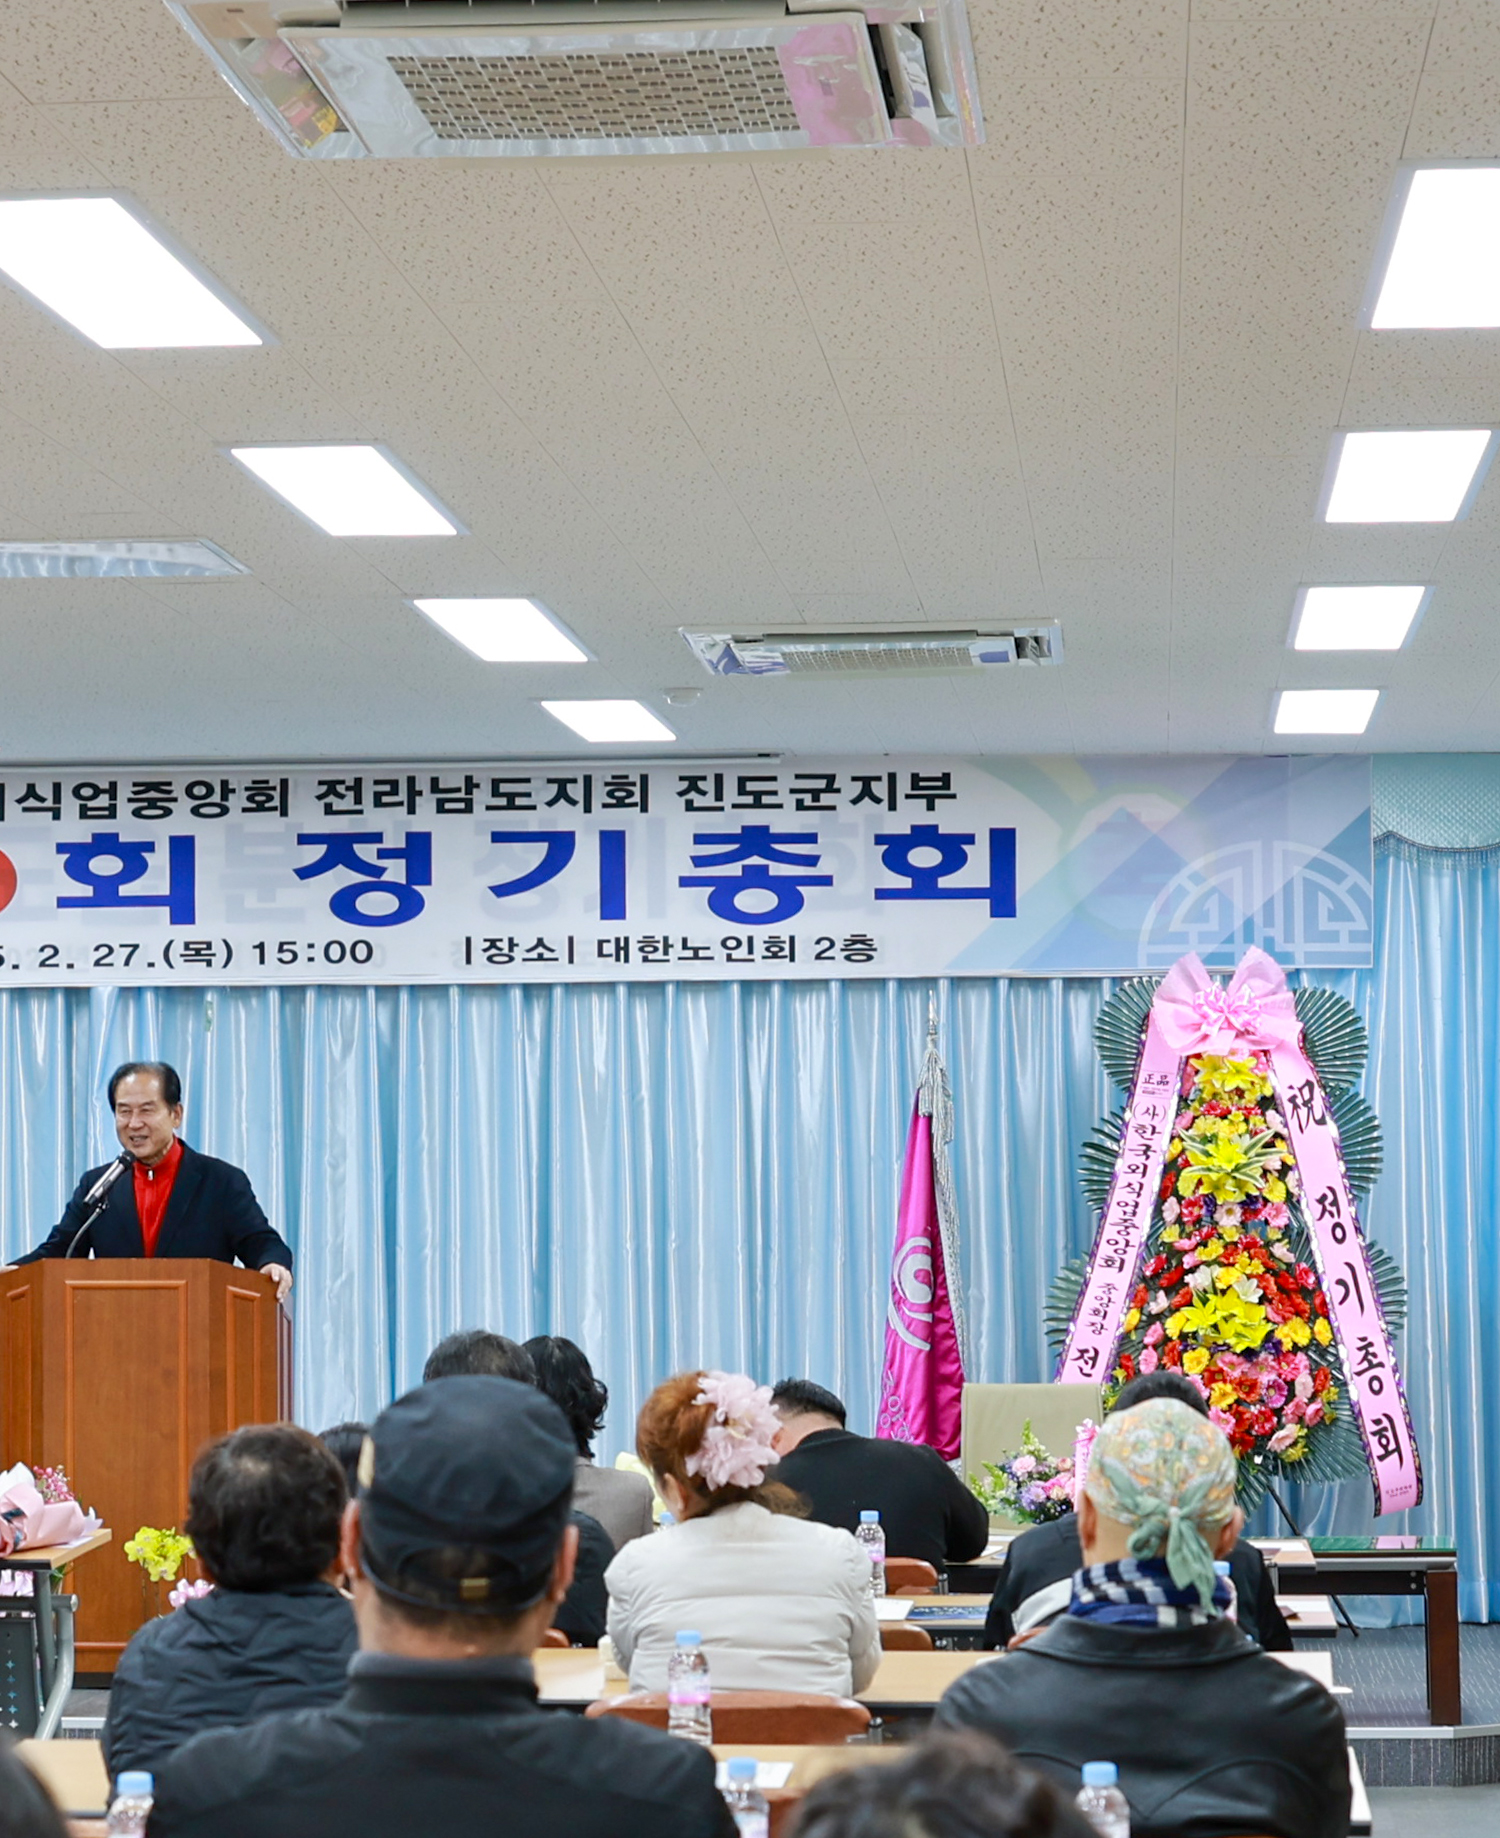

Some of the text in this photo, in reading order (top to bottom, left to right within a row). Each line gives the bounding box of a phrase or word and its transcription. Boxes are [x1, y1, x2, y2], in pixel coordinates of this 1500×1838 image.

[314, 772, 651, 816] 전라남도지회
[676, 770, 958, 812] 진도군지부
[292, 824, 1017, 928] 정기총회
[39, 945, 75, 970] 2.
[92, 939, 234, 970] 27.(목)
[252, 939, 374, 966] 15:00
[597, 934, 797, 964] 대한노인회
[814, 934, 879, 963] 2층
[1287, 1079, 1327, 1134] 祝
[1315, 1186, 1404, 1471] 정기총회
